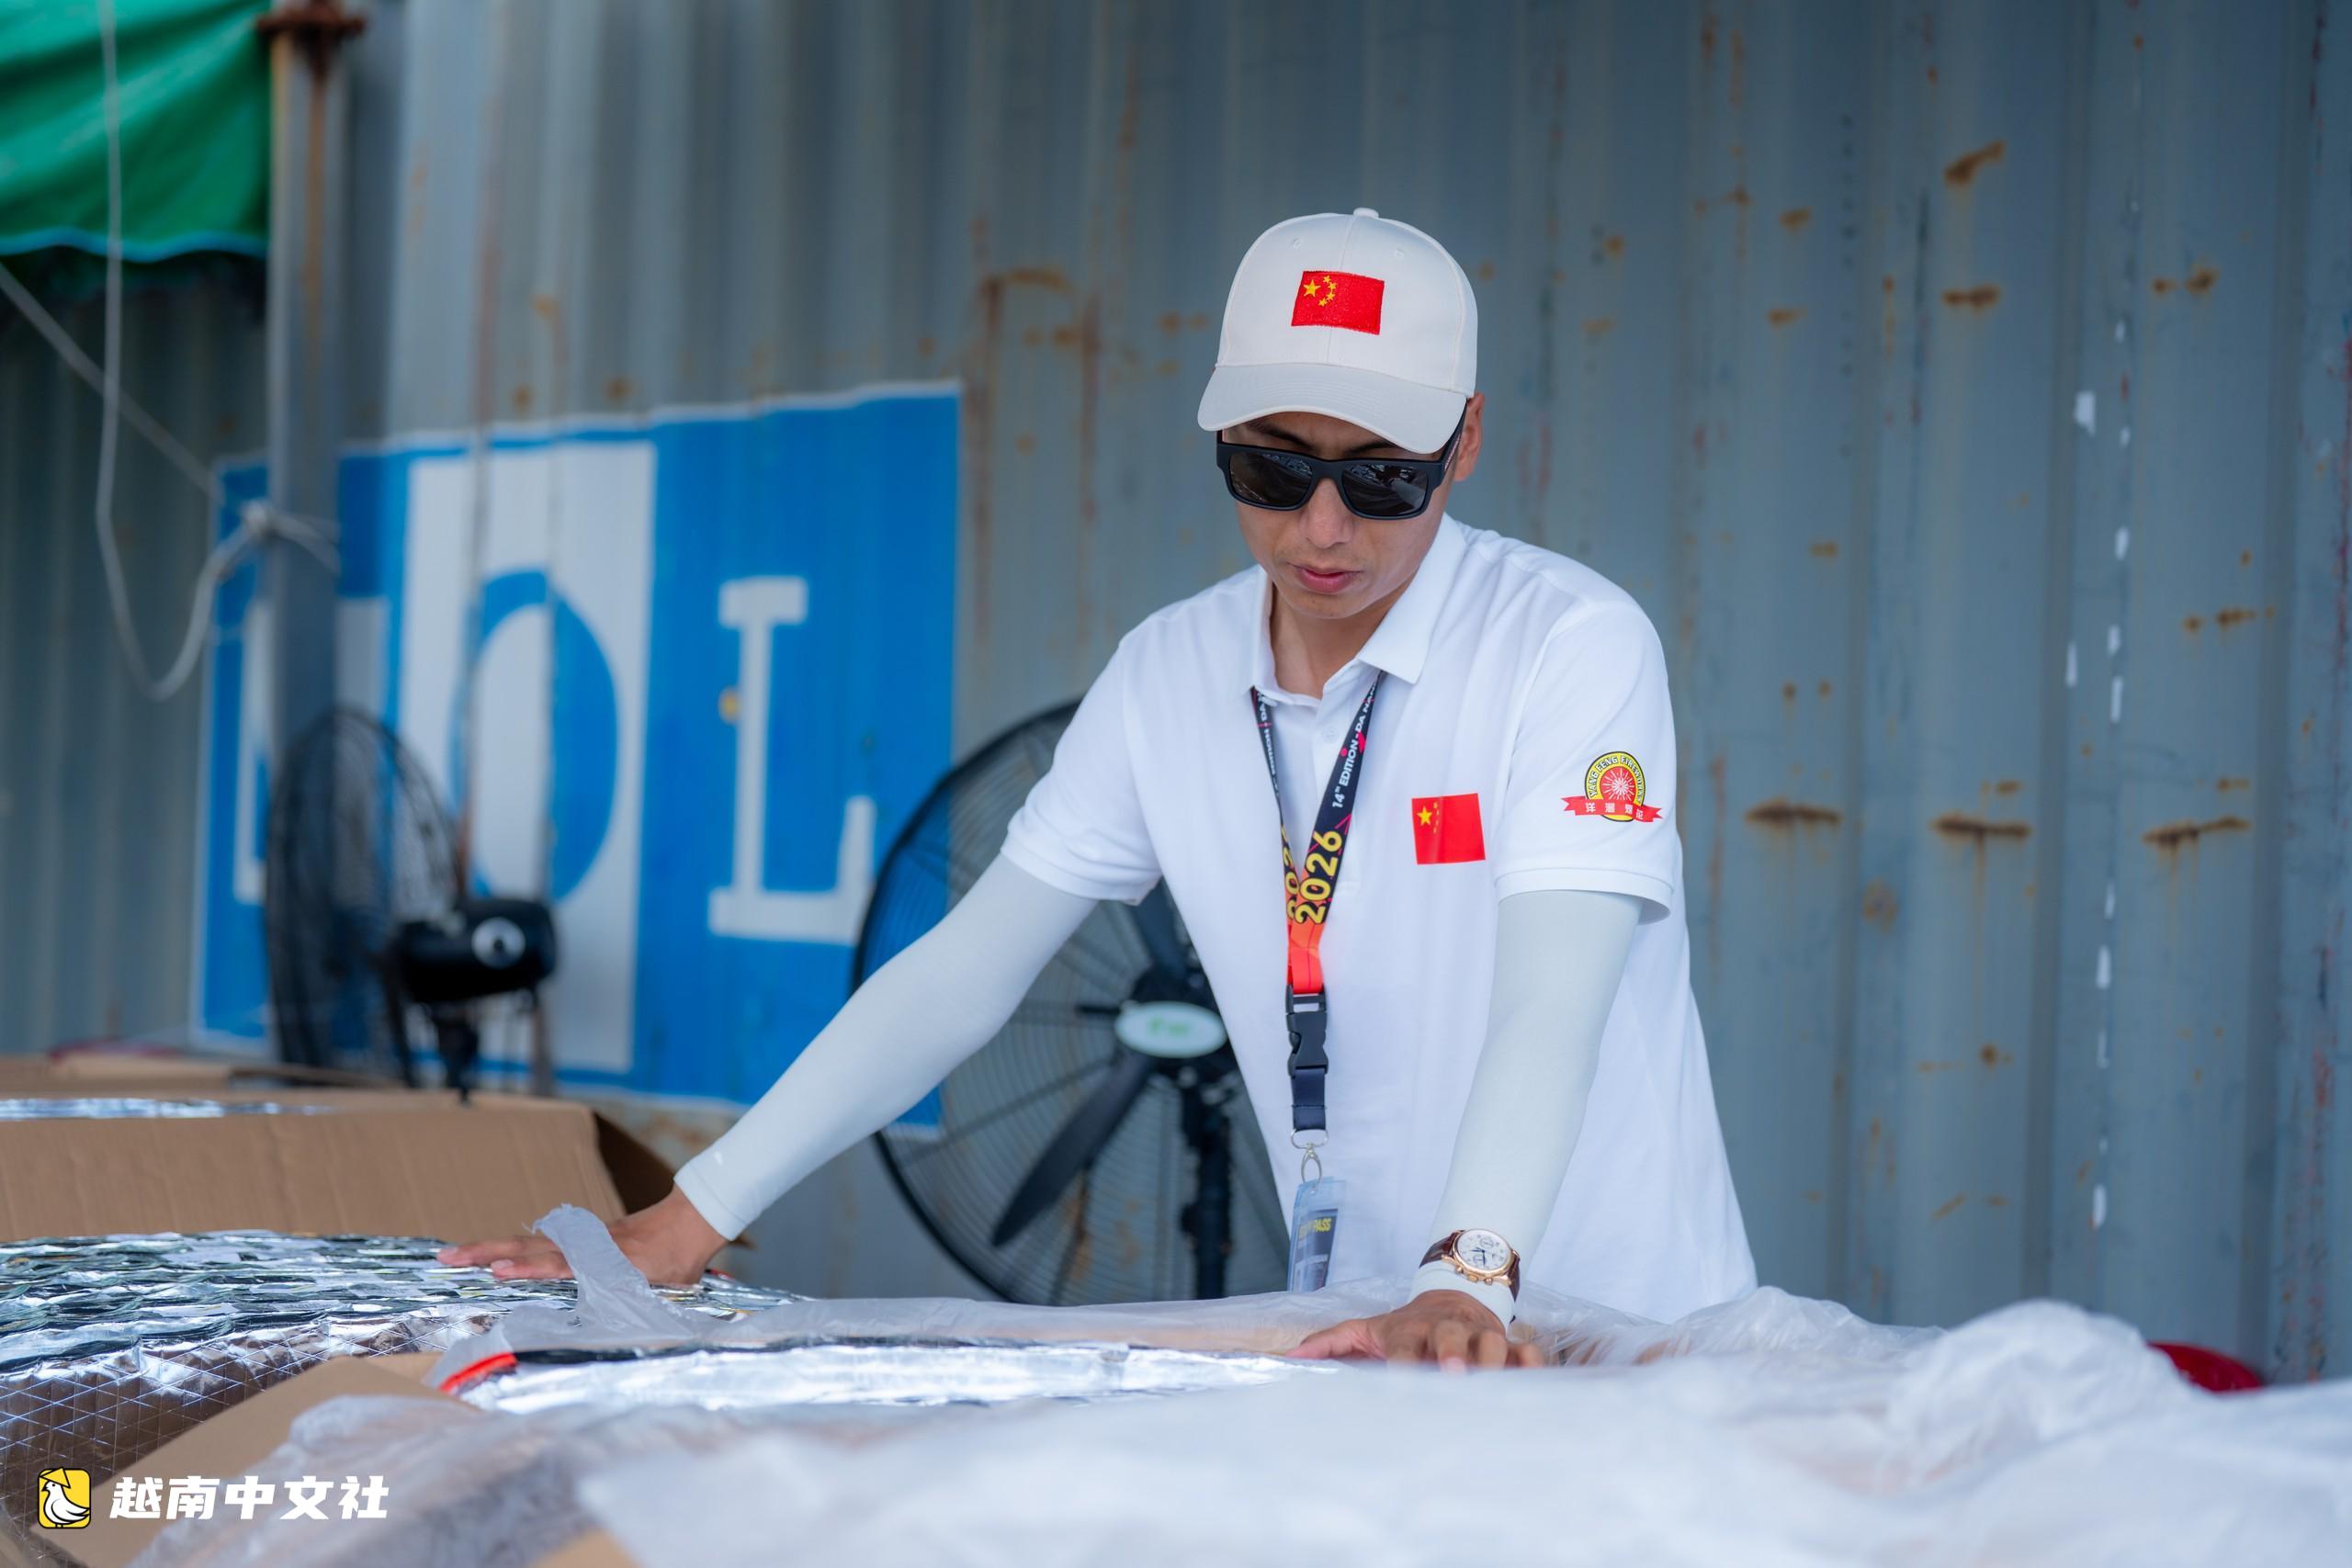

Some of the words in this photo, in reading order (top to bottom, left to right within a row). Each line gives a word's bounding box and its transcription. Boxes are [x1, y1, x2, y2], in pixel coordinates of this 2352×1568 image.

[233, 567, 877, 946] OL
[1339, 739, 1359, 786] EDITION
[1354, 716, 1366, 733] DA
[1589, 772, 1598, 797] YANG
[1596, 756, 1618, 772] FENG
[1295, 829, 1343, 924] 2026
